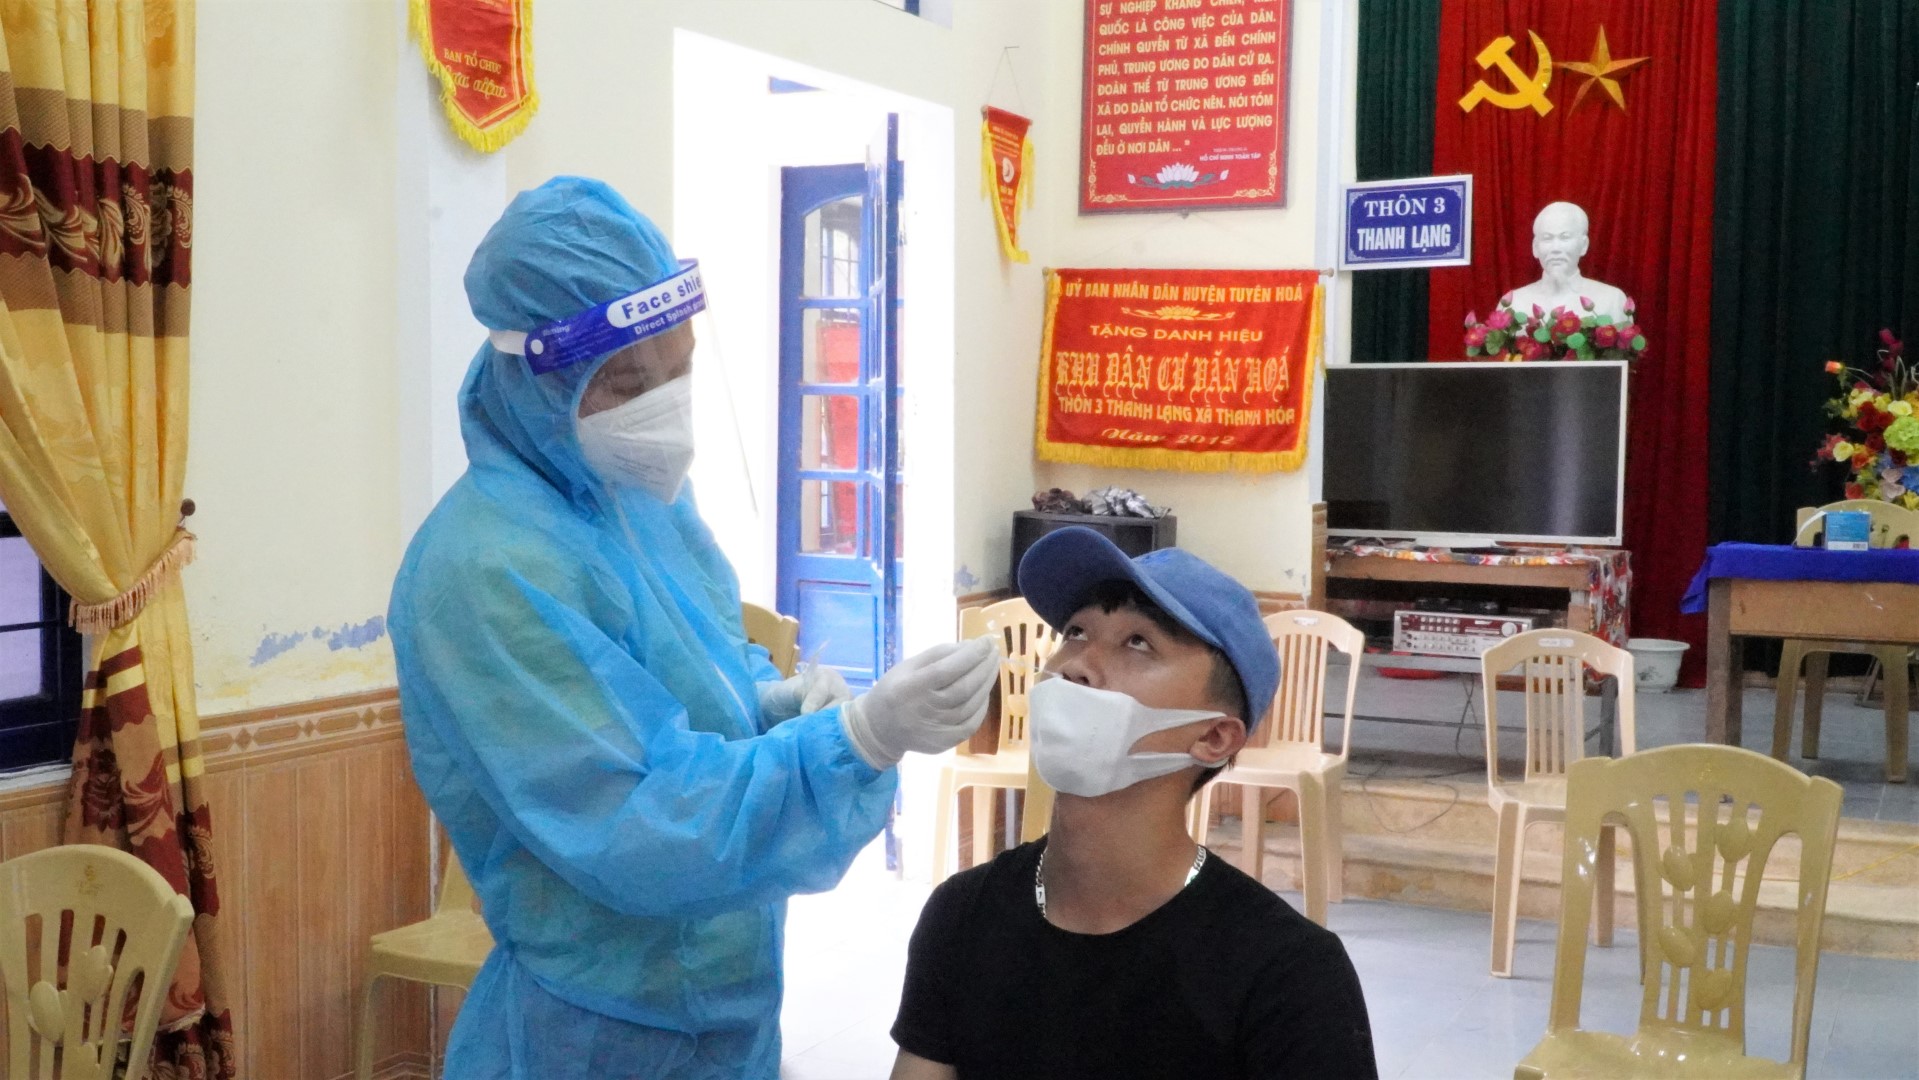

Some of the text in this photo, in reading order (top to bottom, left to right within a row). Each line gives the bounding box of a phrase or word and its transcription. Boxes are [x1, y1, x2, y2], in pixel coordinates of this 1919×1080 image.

[1099, 2, 1113, 18] SỰ
[1099, 8, 1276, 35] QUỐC LÀ CÔNG VIỆC CỦA DÂN.
[1099, 29, 1276, 56] CHÍNH QUYỀN TỪ XÃ ĐẾN CHÍNH
[1098, 49, 1274, 76] PHỦ, TRUNG ƯƠNG DO DÂN CỬ RA.
[1097, 68, 1274, 96] ĐOÀN THỂ TỪ TRUNG ƯƠNG ĐẾN
[1097, 91, 1273, 115] XÃ DO DÂN TỔ CHỨC NÊN. NÓI TÓM
[1096, 114, 1273, 139] LẠI, QUYỀN HÀNH VÀ LỰC LƯỢNG
[1096, 138, 1115, 156] ĐỀU
[1127, 141, 1146, 154] NƠI
[1364, 194, 1446, 217] THÔN 3
[1357, 224, 1451, 253] THANH LẠNG
[621, 292, 672, 320] Face
[1085, 283, 1110, 298] BAN
[1113, 280, 1149, 299] NHÂN
[1153, 283, 1179, 301] DÂN
[1182, 284, 1226, 306] HUYỆN
[1229, 284, 1271, 302] TUYÊN
[1275, 282, 1302, 301] HOÁ
[633, 315, 667, 336] Direct
[666, 303, 693, 323] Splash
[1090, 323, 1263, 344] TẶNG DANH HIỆU
[1055, 351, 1100, 397] KHU
[1103, 344, 1153, 399] DÂN
[1189, 349, 1241, 403] VĂN
[1242, 346, 1289, 404] HOÁ
[1058, 393, 1295, 427] THÔN 3 THANH LẠNG XÃ THANH HÓA
[1175, 434, 1235, 445] 2012
